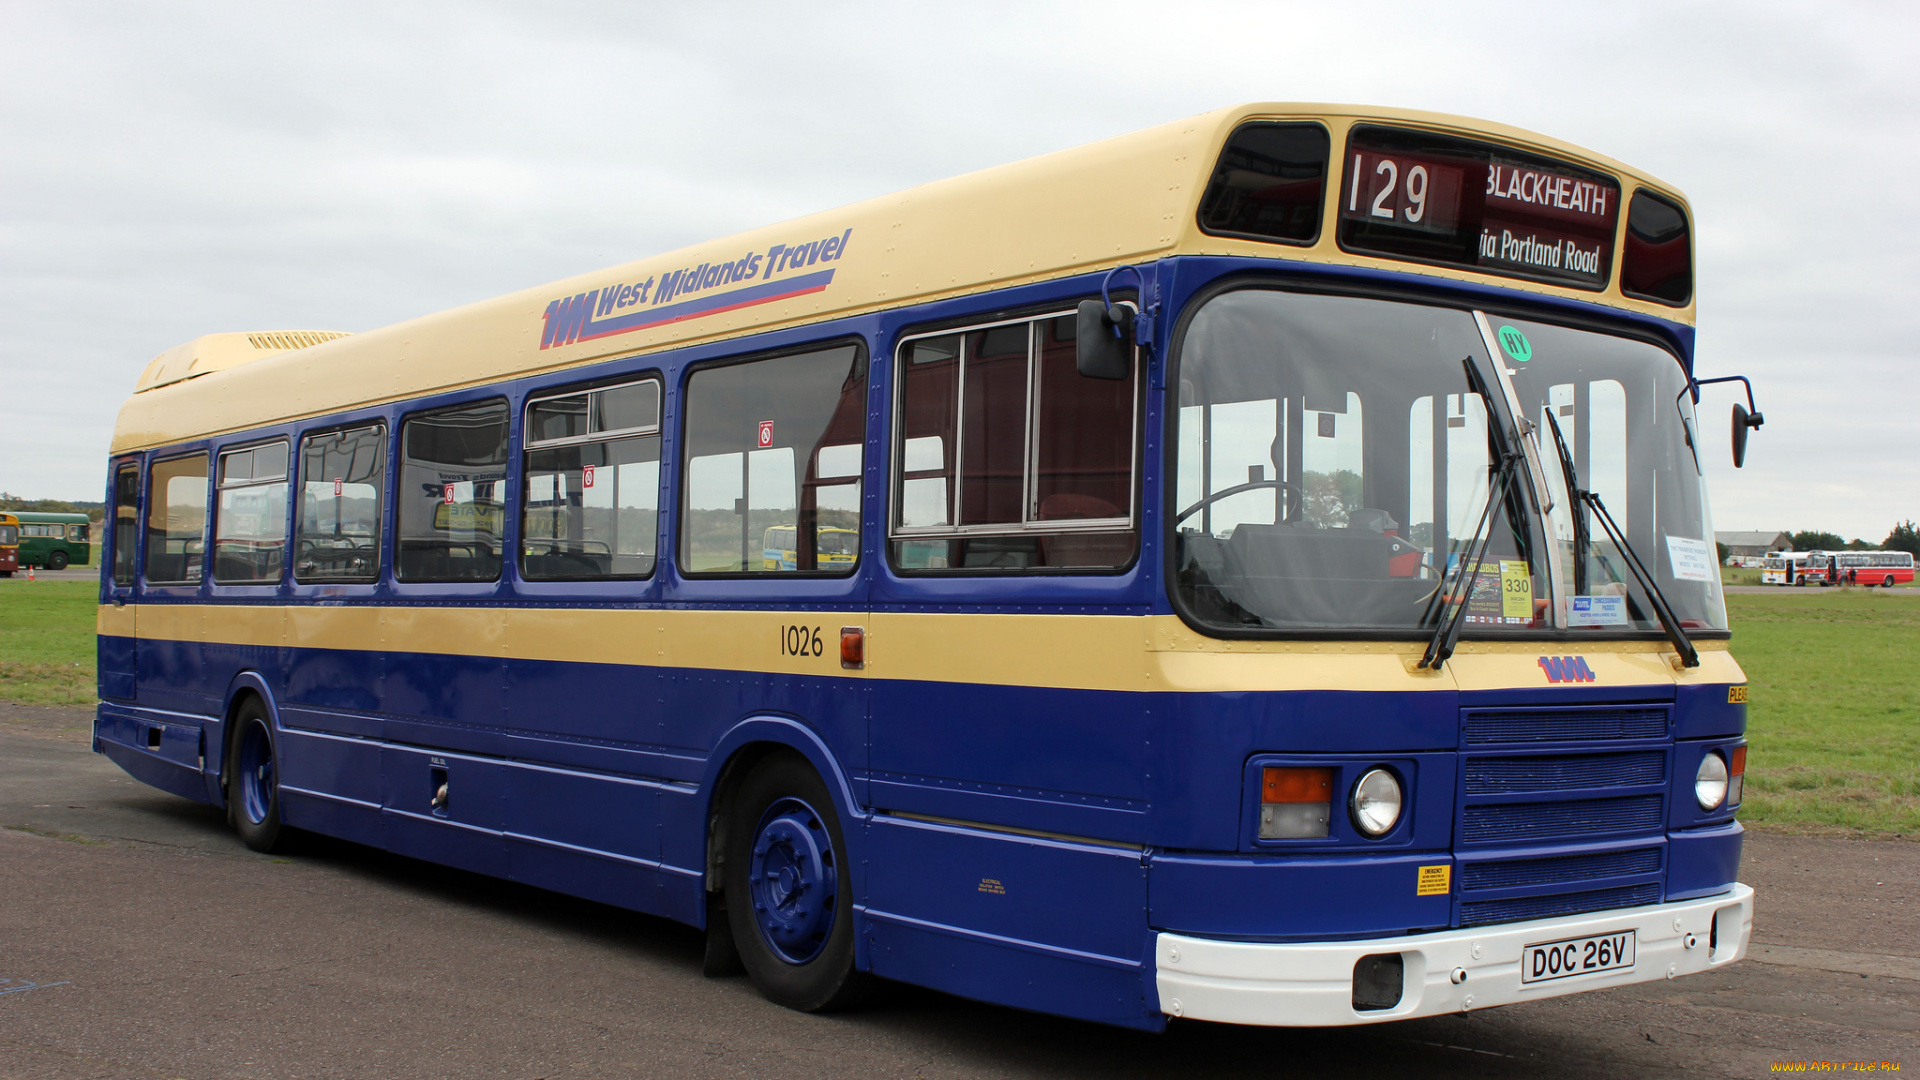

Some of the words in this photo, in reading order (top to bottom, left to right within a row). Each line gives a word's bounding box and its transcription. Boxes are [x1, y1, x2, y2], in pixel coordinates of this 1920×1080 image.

[1349, 154, 1429, 223] 129
[1486, 164, 1606, 216] BLACKHEATH
[596, 276, 653, 317] West
[651, 251, 763, 305] Midlands
[762, 228, 853, 280] Travel
[1500, 229, 1562, 268] Portland
[1564, 241, 1600, 274] Road
[1503, 332, 1527, 354] HY
[1505, 578, 1529, 593] 330
[782, 625, 823, 657] 1026
[1532, 944, 1577, 977] DOC
[1583, 936, 1626, 969] 26V
